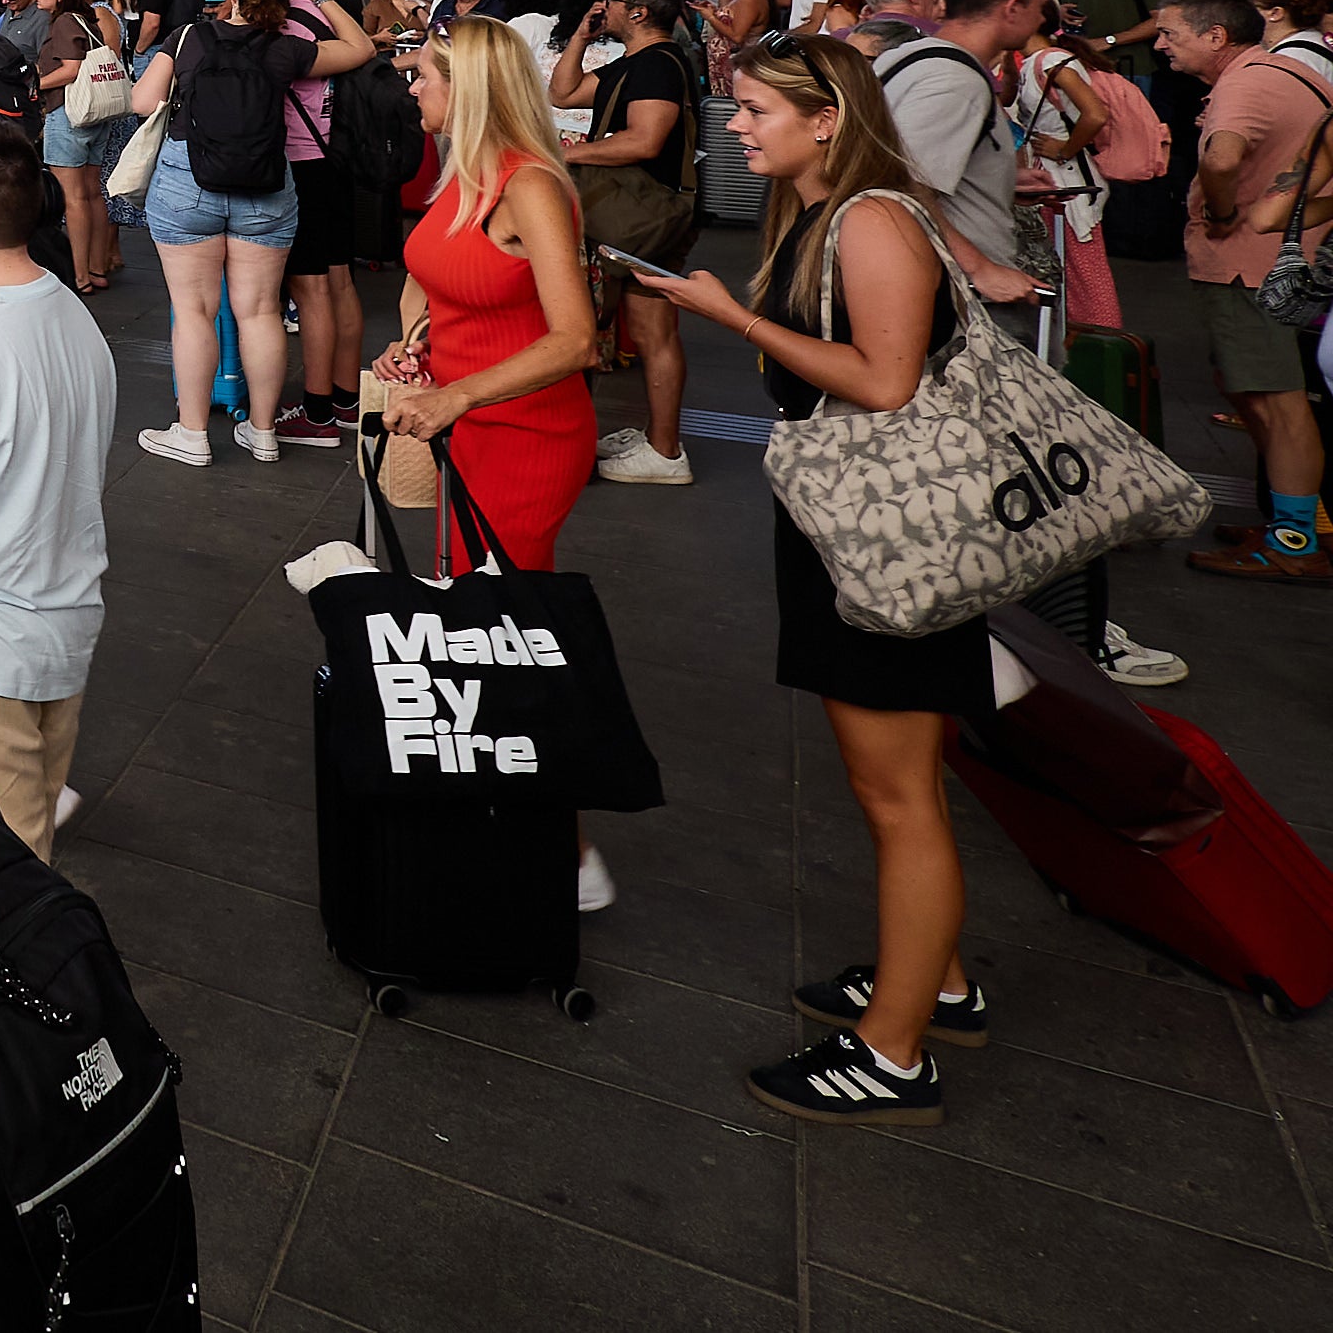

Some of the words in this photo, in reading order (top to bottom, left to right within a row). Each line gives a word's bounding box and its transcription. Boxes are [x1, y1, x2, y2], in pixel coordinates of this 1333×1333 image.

[90, 73, 108, 83] MON
[98, 62, 118, 73] PARIS
[992, 431, 1090, 533] alo
[366, 612, 567, 666] Made
[374, 663, 481, 733] By
[384, 719, 538, 774] Fire
[76, 1042, 101, 1071] THE
[61, 1059, 103, 1101] NORTH
[79, 1076, 109, 1112] FACE
